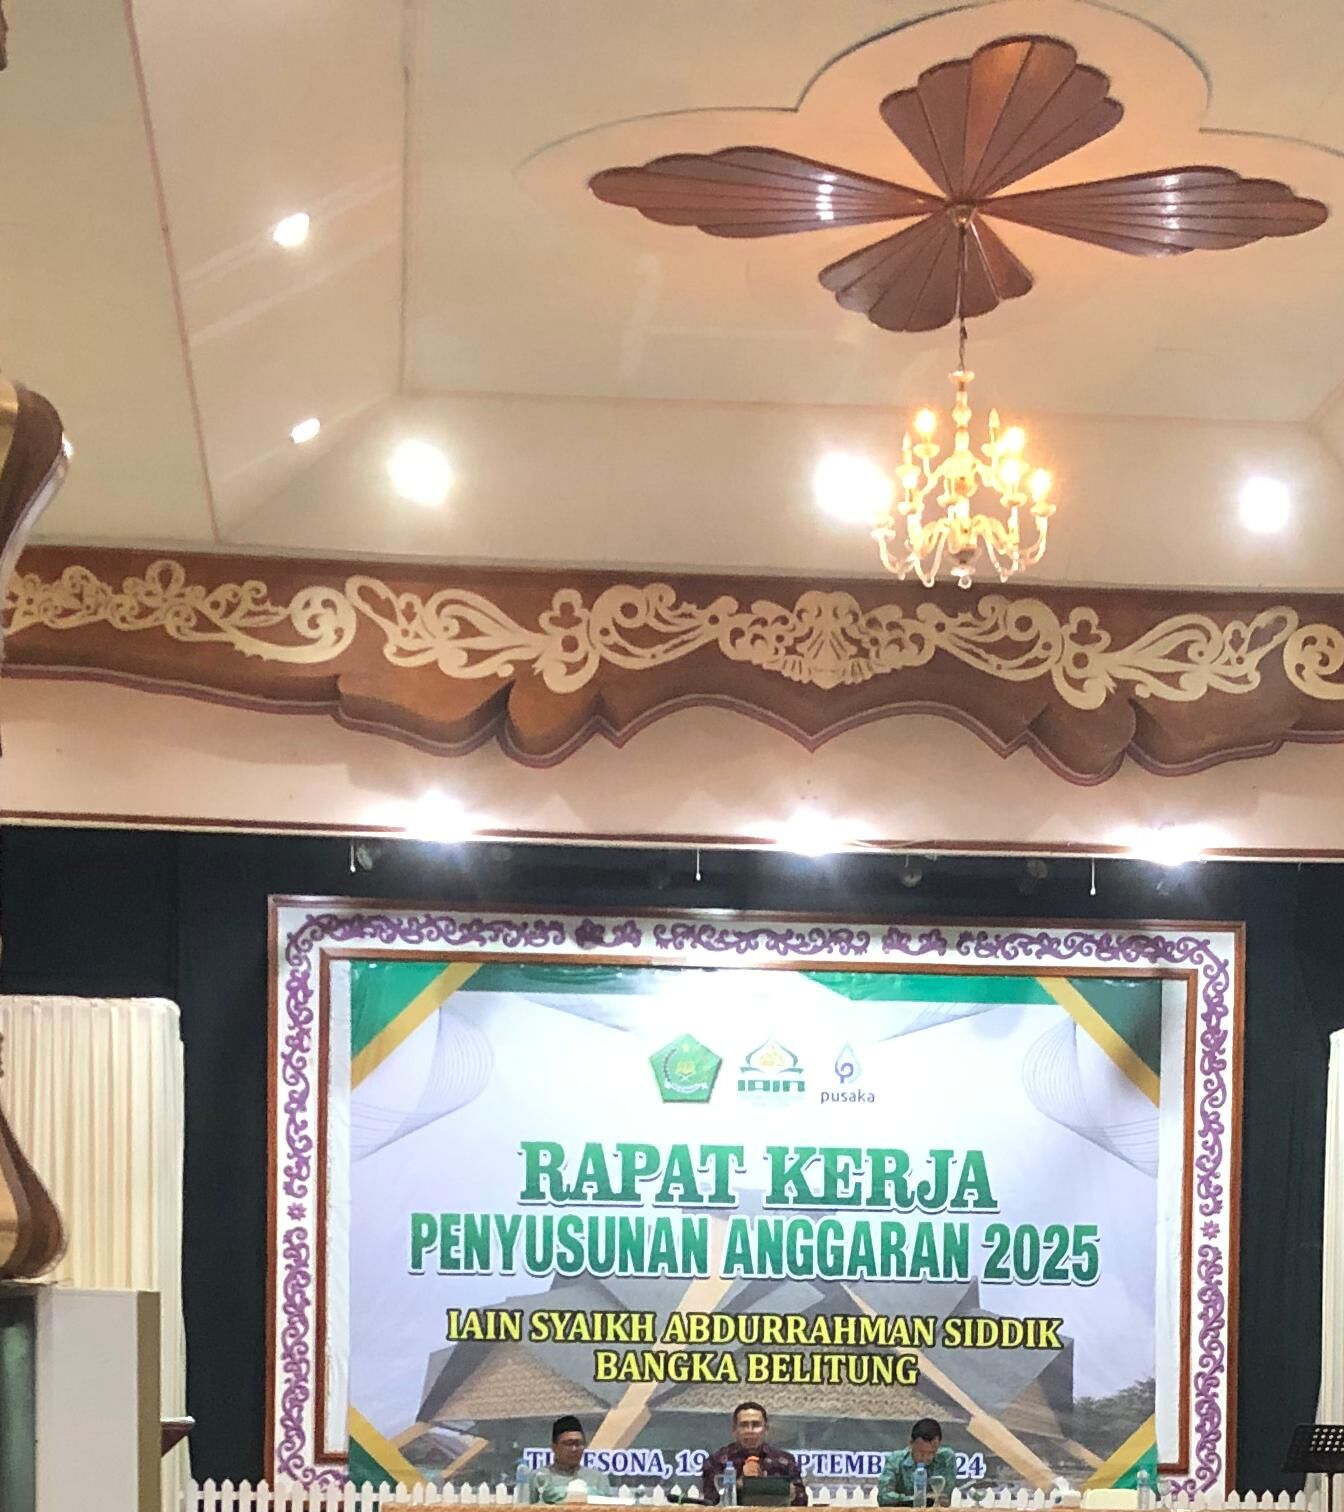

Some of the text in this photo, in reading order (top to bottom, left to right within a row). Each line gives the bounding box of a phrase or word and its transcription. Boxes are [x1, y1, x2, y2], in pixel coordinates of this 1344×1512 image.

[820, 1088, 875, 1105] pusaka
[518, 1140, 999, 1210] RAPAT KERJA
[409, 1212, 1101, 1284] PENYUSUNAN ANGGARAN 2025
[447, 1309, 1064, 1348] IAIN SYAIKH ABDURRAHMAN SIDDIK
[593, 1350, 920, 1385] BANGKA BELITUNG
[583, 1451, 671, 1476] ESONA,
